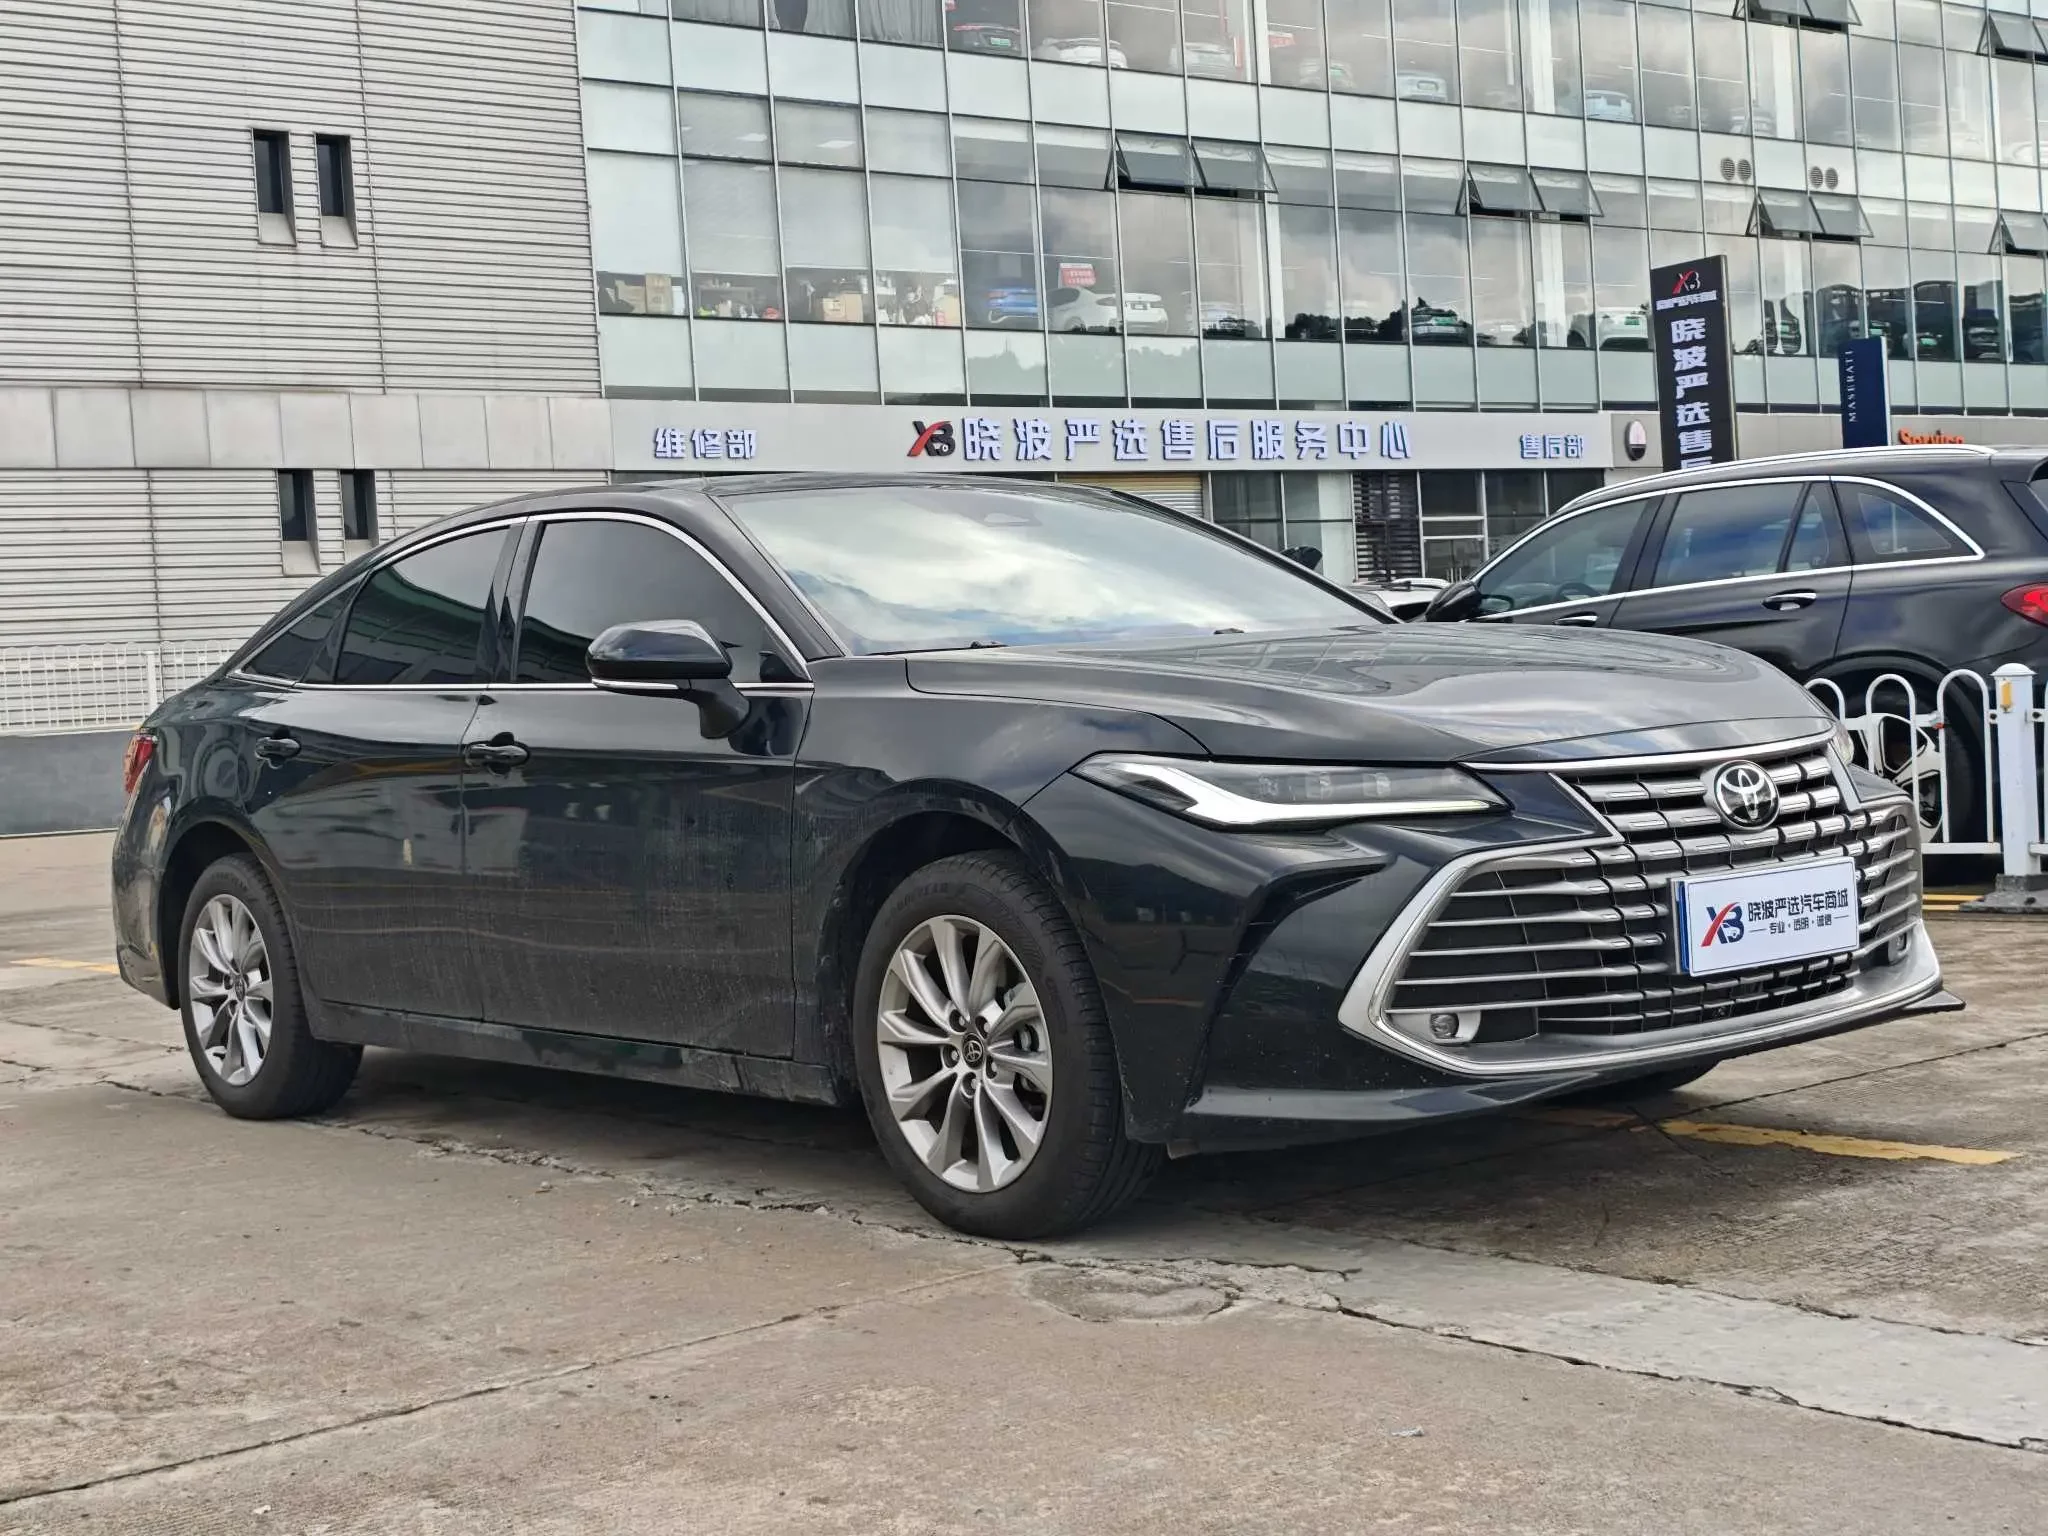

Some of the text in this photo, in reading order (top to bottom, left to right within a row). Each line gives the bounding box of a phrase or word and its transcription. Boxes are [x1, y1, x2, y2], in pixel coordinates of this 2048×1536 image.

[1845, 350, 1857, 423] MASERATI
[653, 427, 757, 460] 维修部
[962, 417, 1412, 461] 晓波严选售后服务中心
[1518, 433, 1585, 459] 售后部
[1747, 888, 1849, 922] 晓波严选汽车商城
